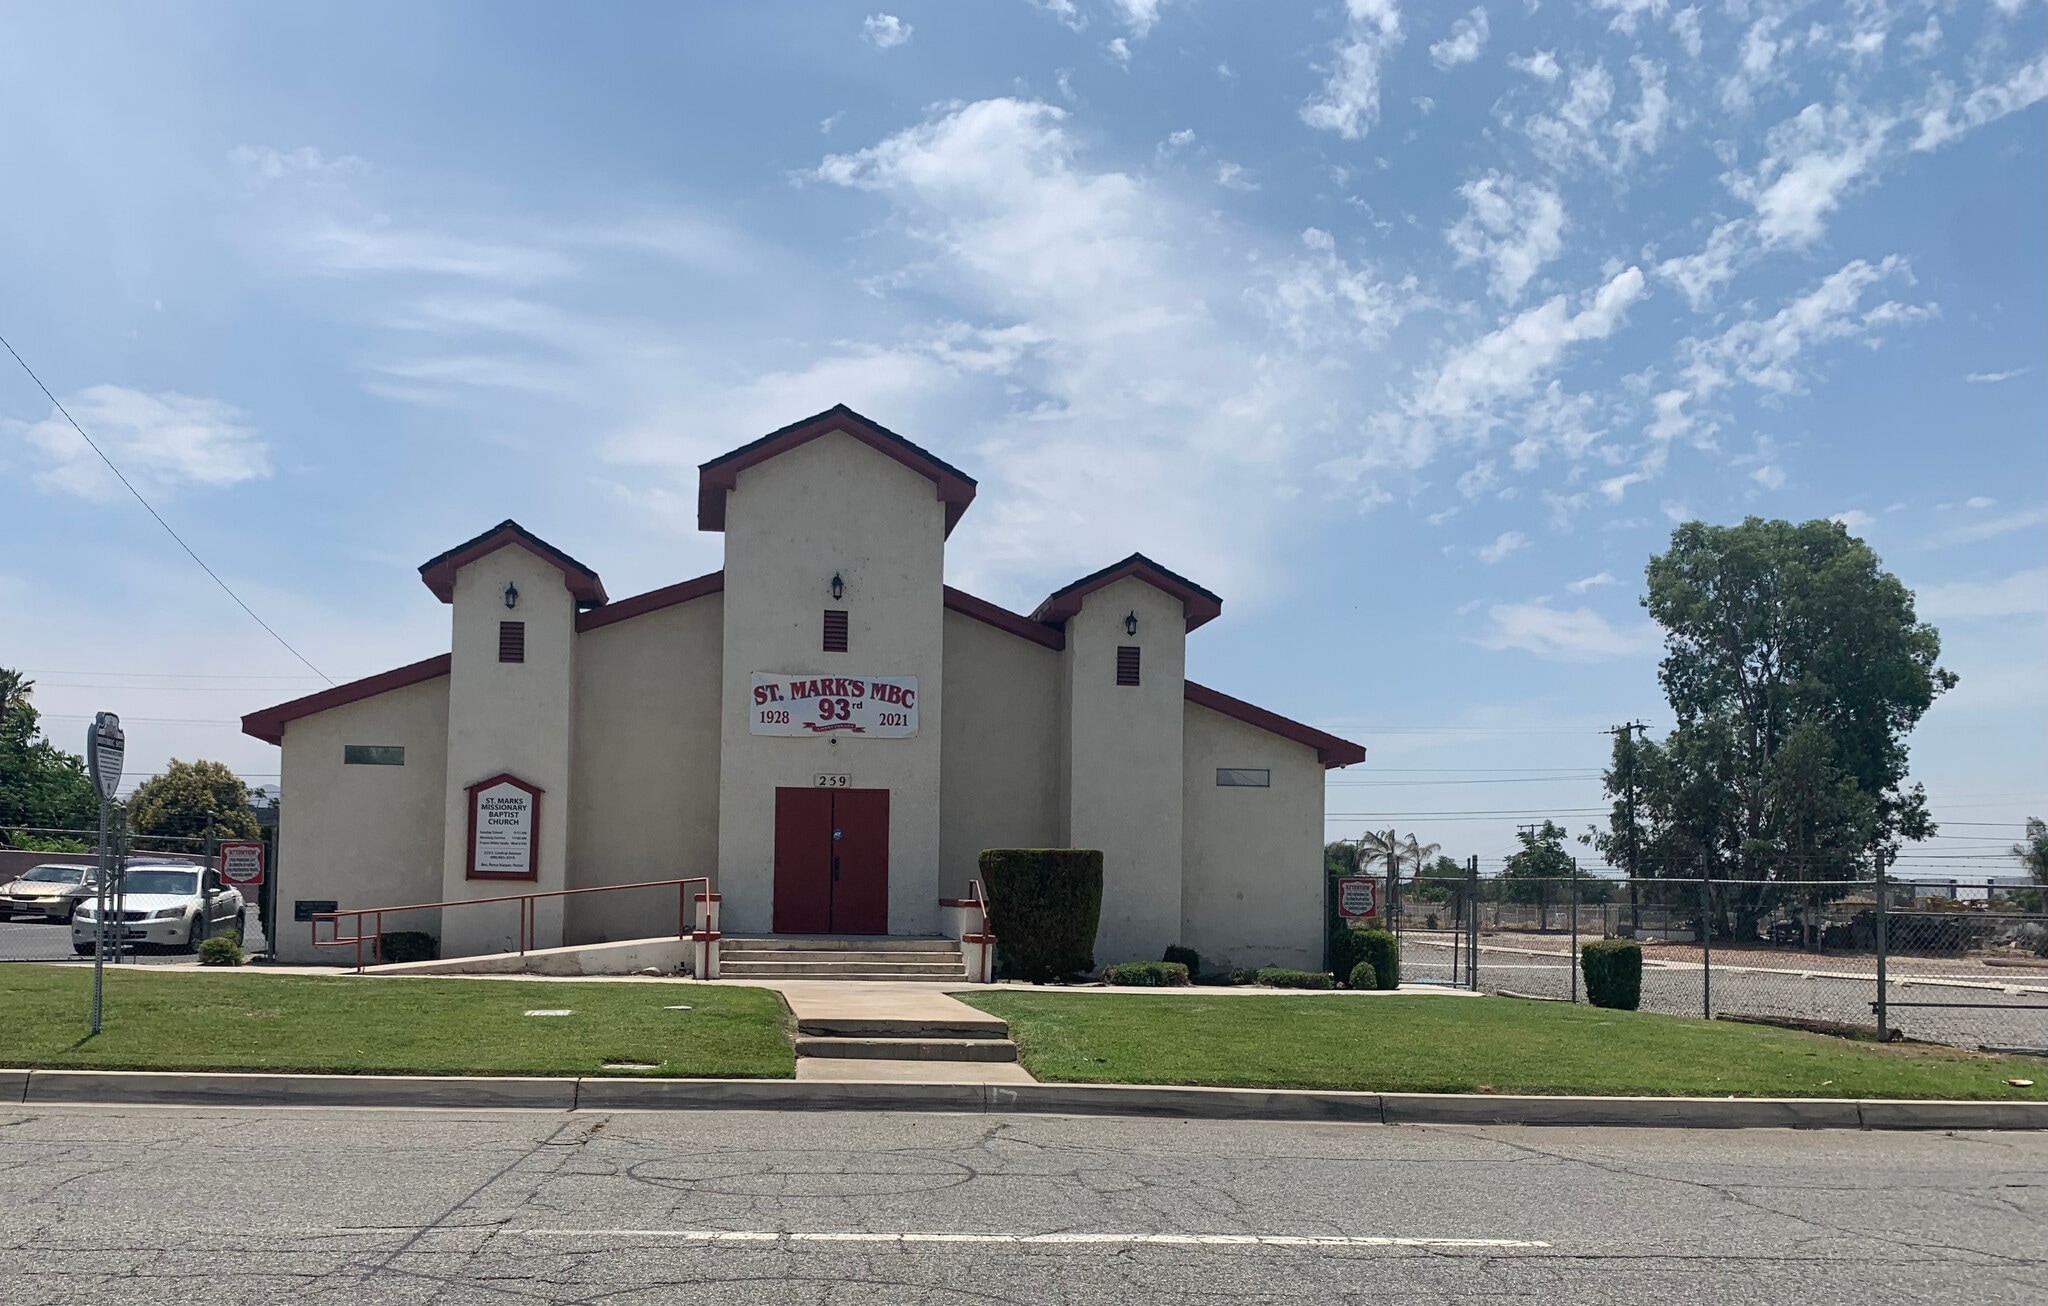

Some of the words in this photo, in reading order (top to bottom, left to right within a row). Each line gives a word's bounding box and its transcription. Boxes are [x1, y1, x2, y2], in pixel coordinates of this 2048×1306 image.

[753, 683, 785, 706] ST.
[789, 677, 866, 700] MARK'S
[869, 682, 915, 709] MBC
[759, 710, 790, 724] 1928
[879, 713, 909, 727] 2021
[819, 775, 846, 787] 259
[481, 803, 528, 811] MISSIONARY
[497, 797, 524, 805] MARKS
[487, 818, 520, 826] CHURCH
